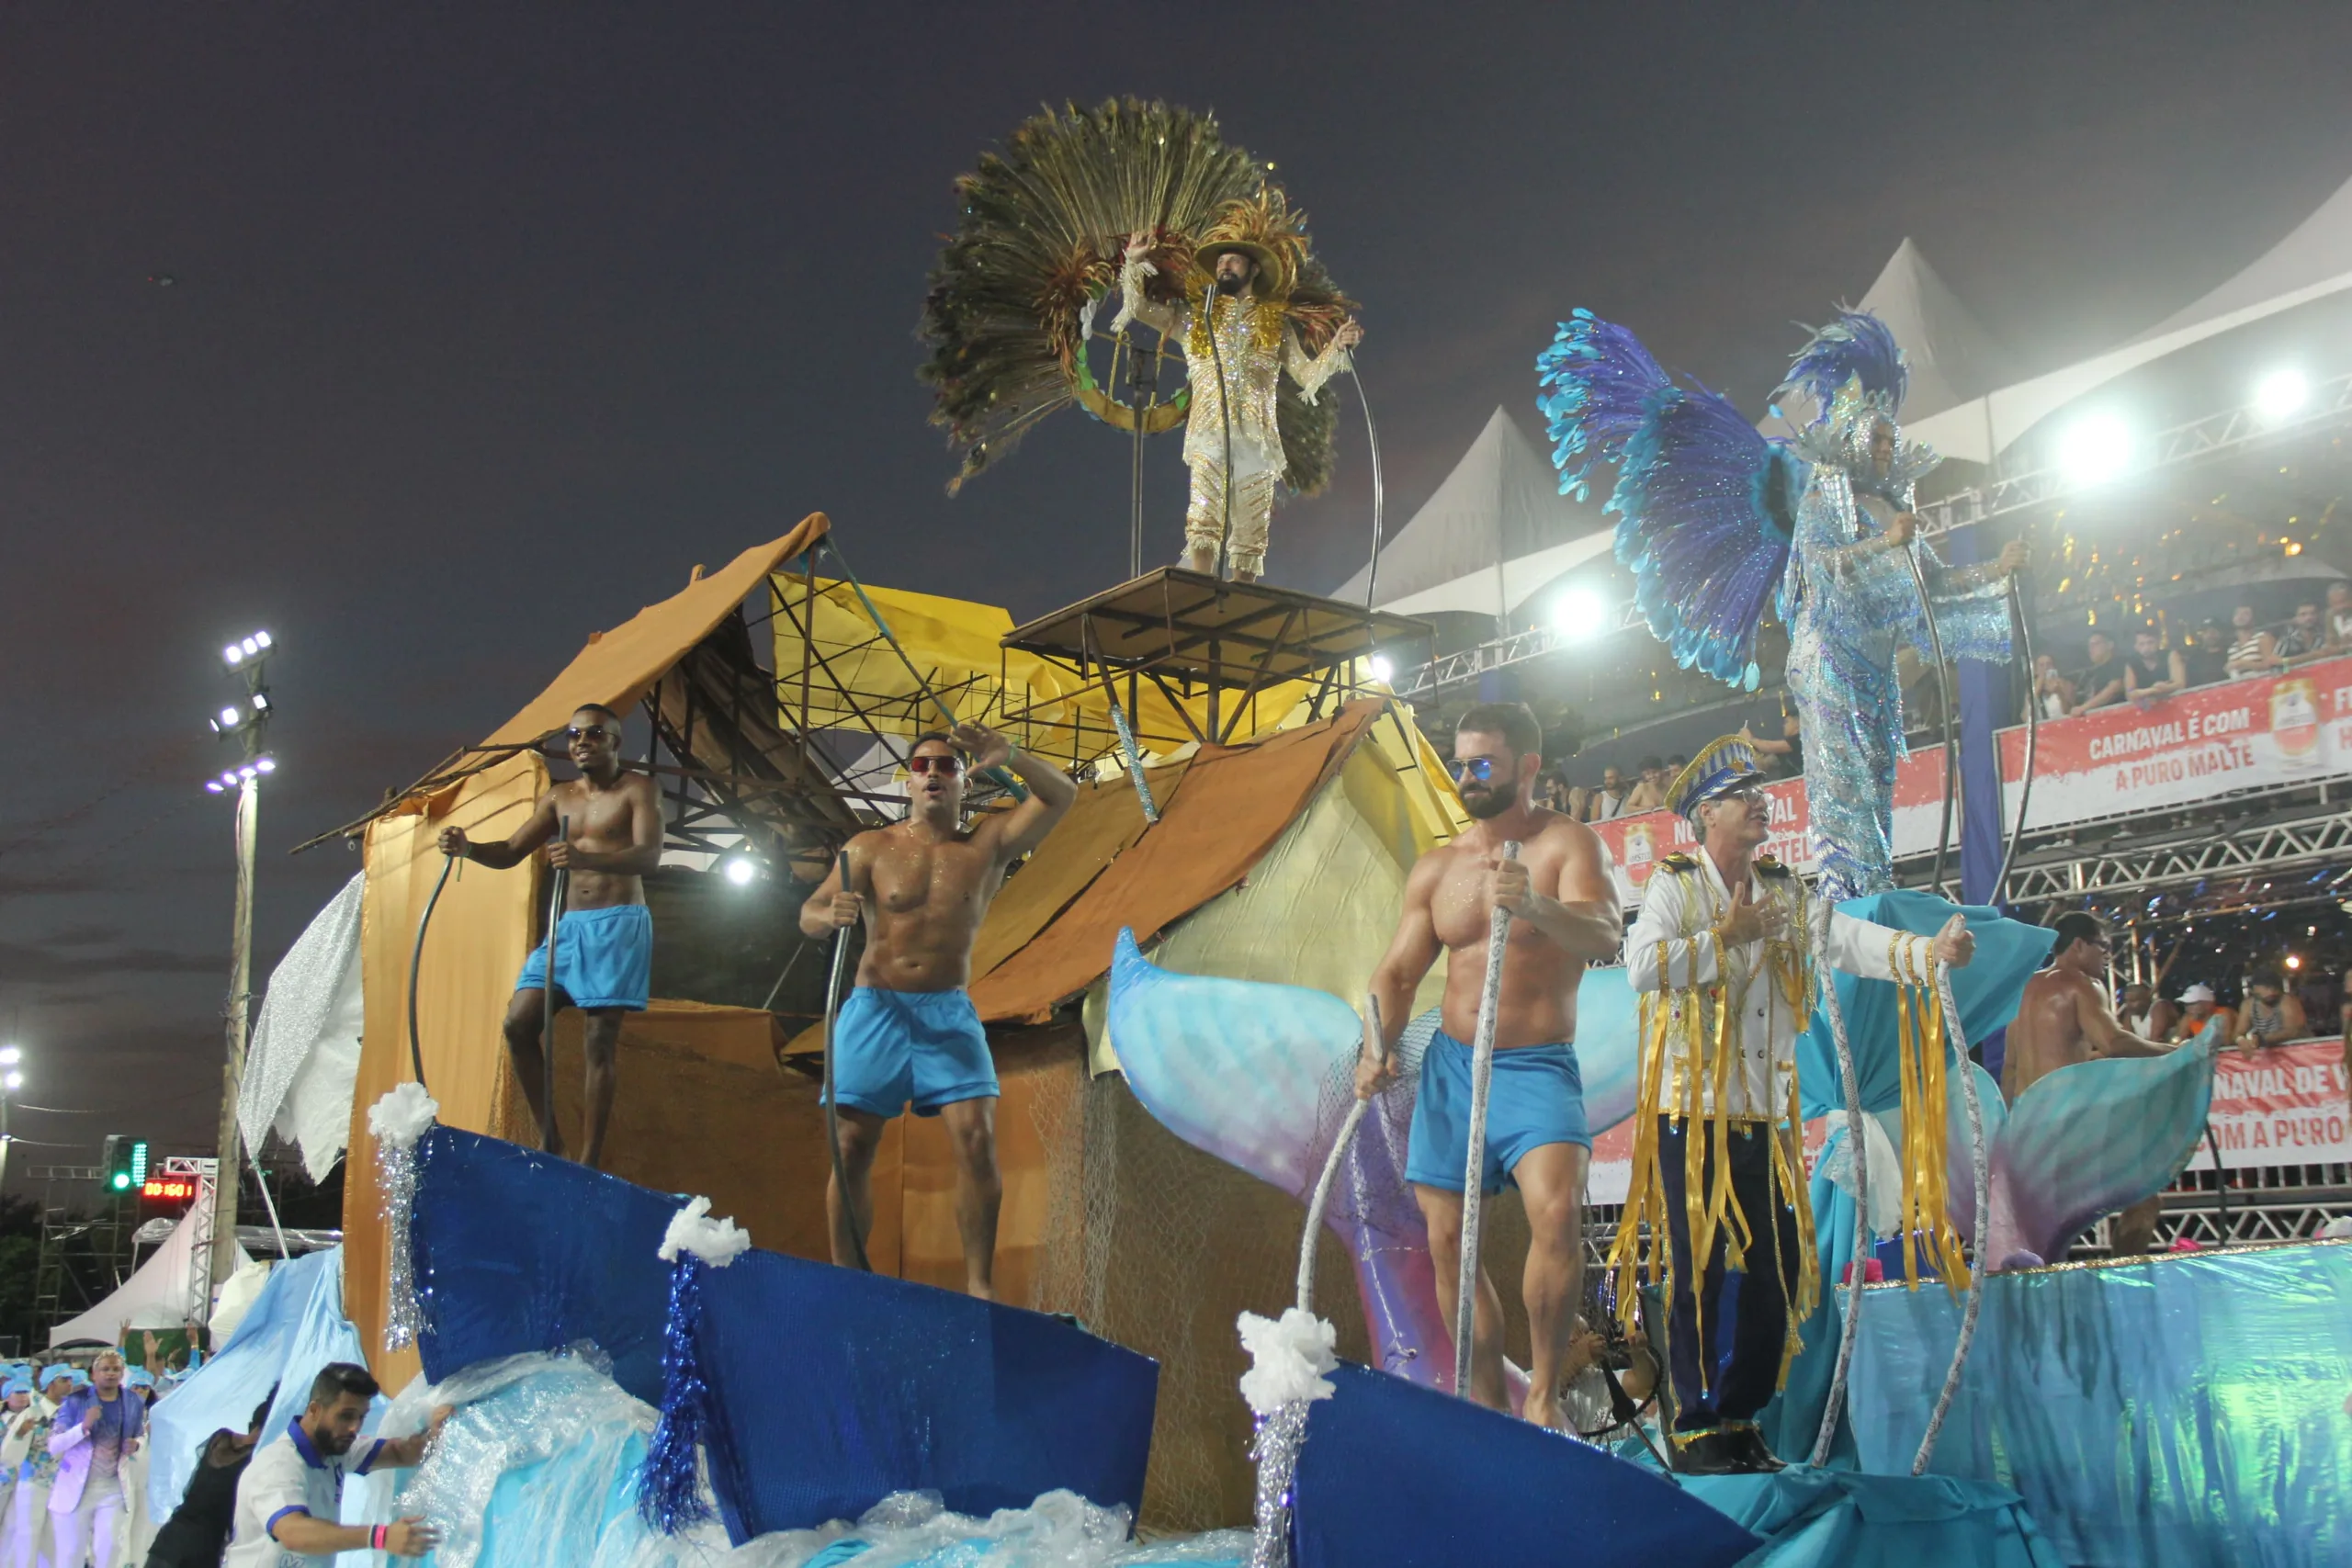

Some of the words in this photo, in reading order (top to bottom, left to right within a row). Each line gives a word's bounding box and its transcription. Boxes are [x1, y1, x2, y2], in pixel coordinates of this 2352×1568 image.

[2089, 720, 2185, 760] CARNAVAL
[2188, 710, 2200, 739] É
[2203, 706, 2250, 736] COM
[2116, 769, 2129, 792] A
[2132, 759, 2184, 790] PURO
[2188, 743, 2256, 778] MALTE
[2212, 1067, 2290, 1100] NAVAL
[2295, 1065, 2330, 1094] DE
[2254, 1121, 2269, 1148] A
[2274, 1115, 2345, 1147] PURO
